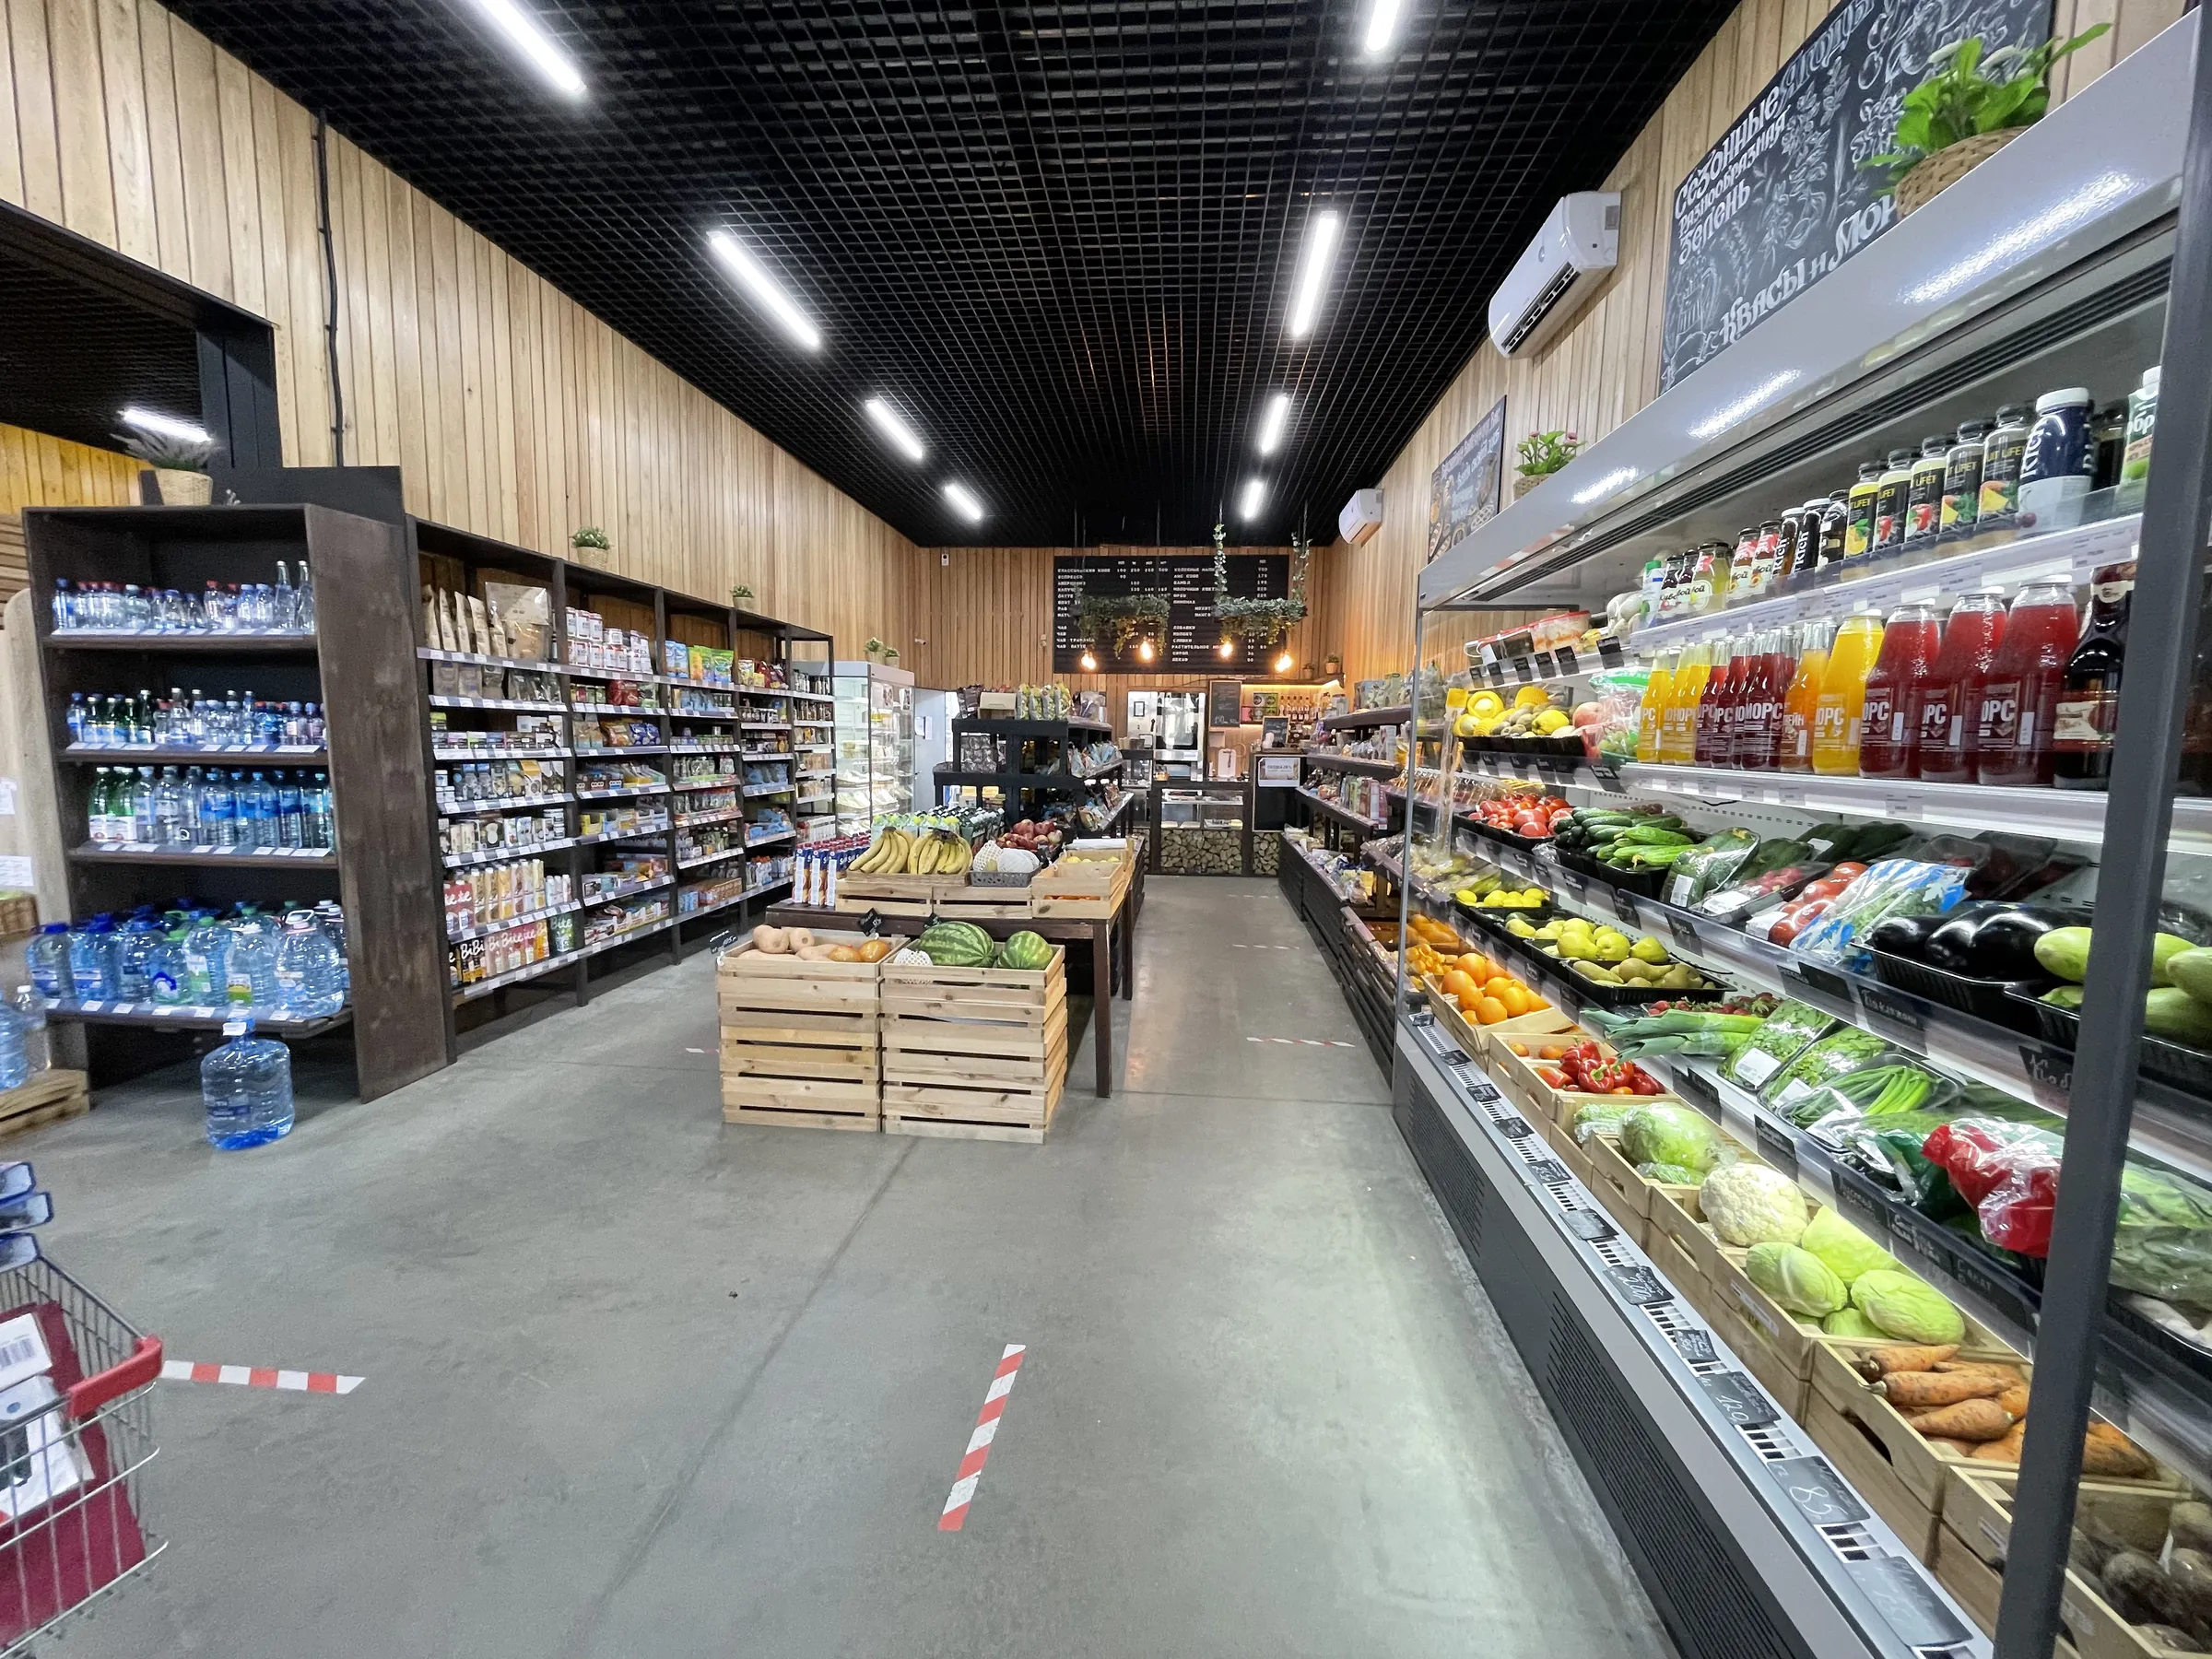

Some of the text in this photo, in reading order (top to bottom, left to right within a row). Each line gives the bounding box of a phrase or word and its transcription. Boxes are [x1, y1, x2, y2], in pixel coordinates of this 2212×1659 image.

[1816, 708, 1845, 726] ОРС
[1862, 701, 1889, 722] ОРС
[1982, 700, 2016, 722] ОРС
